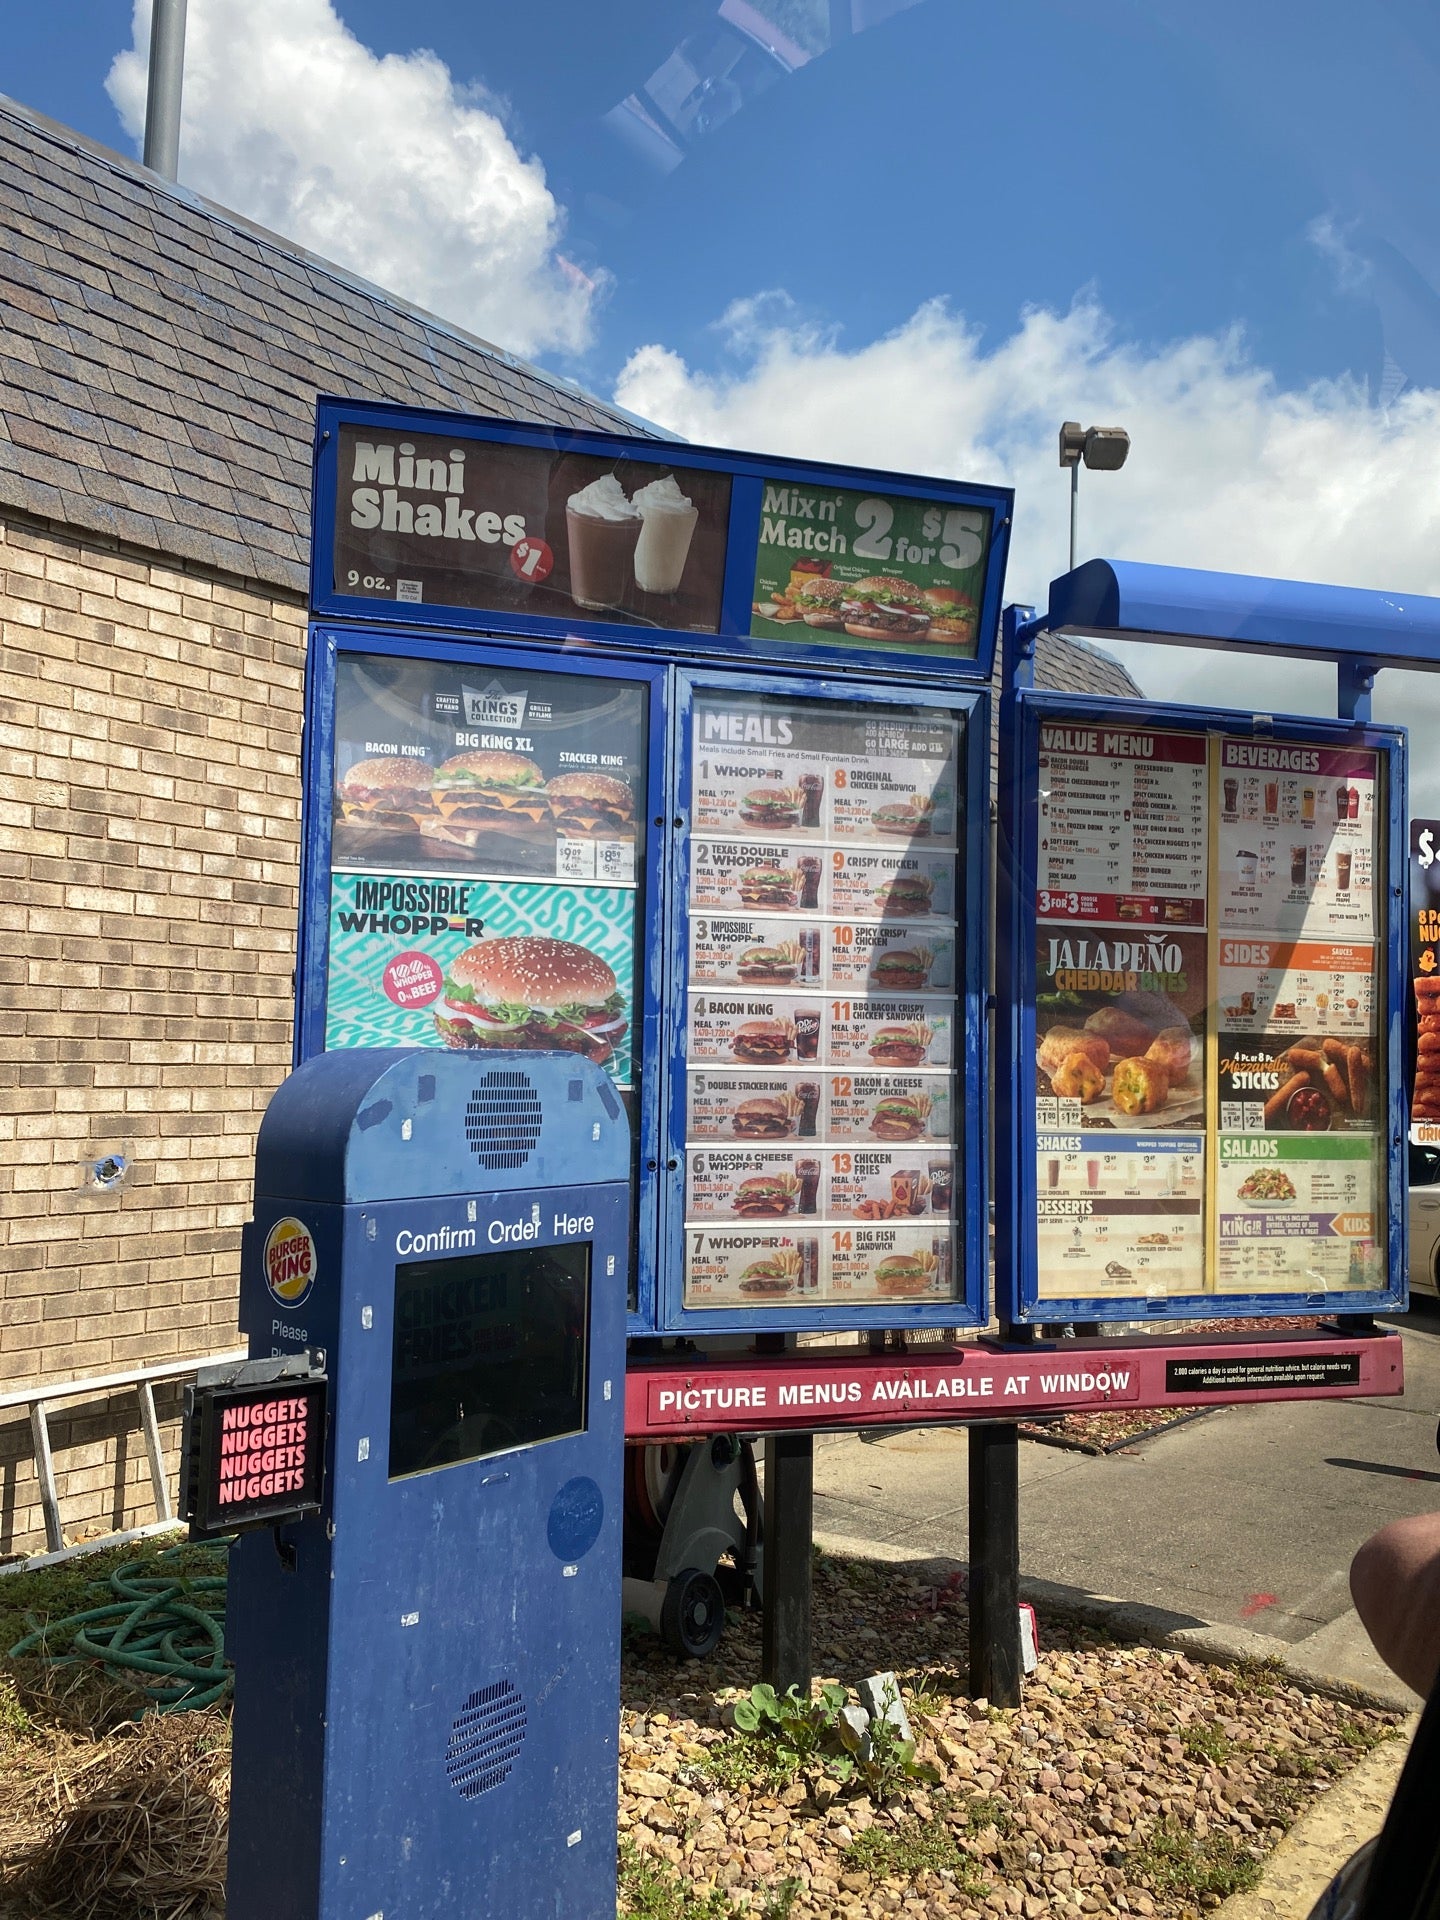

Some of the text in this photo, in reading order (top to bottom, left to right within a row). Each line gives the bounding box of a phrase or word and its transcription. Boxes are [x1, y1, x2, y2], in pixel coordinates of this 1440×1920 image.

[352, 441, 466, 494] Mini
[762, 485, 817, 517] Mix
[351, 487, 526, 546] Shakes
[759, 517, 847, 555] Match
[852, 498, 894, 561] 2
[896, 537, 936, 565] for
[516, 541, 542, 576] $1
[347, 570, 359, 586] 9
[362, 574, 391, 591] oz.
[436, 696, 459, 704] CRAFTED
[471, 699, 518, 716] KING'S
[471, 713, 517, 724] COLLECTION
[704, 710, 793, 746] MEALS
[365, 742, 398, 755] BACON
[455, 732, 534, 752] BIG KING XL
[1041, 729, 1154, 757] VALUE MENU
[559, 751, 598, 764] STACKER
[699, 744, 870, 765] Meals include Small Fries and Small Fountain Drink
[1226, 744, 1320, 772] BEVERAGES
[699, 759, 709, 780] 1
[834, 768, 893, 789] 8 ORIGINAL
[850, 781, 917, 793] CHICKEN SANDWICH
[696, 843, 789, 864] 2 TEXAS DOUBLE
[833, 851, 919, 871] 9 CRISPY CHICKEN
[1039, 891, 1051, 913] 3
[1051, 898, 1067, 909] FOR
[1418, 909, 1427, 925] 8
[696, 919, 754, 940] 3 IMPOSSIBLE
[832, 925, 908, 946] 10 SPICY CRISPY
[1419, 924, 1440, 942] NU
[855, 936, 888, 947] CHICKEN
[1046, 934, 1183, 977] JALAPEÑO
[1224, 943, 1270, 965] SIDES
[392, 970, 433, 988] WHOPPER
[1055, 969, 1188, 993] CHEDDAR BITES
[411, 981, 437, 999] BEEF
[694, 997, 774, 1017] 4 BACON KING
[831, 1001, 924, 1021] 11 BBQ BACON CRISPY
[853, 1011, 925, 1021] CHICKEN SANDWICH
[1220, 1058, 1290, 1075] Mozzarella
[693, 1075, 788, 1095] 5 DOUBLE STACKER KING
[830, 1076, 923, 1097] 12 BACON & CHEESE
[1231, 1071, 1280, 1089] STICKS
[854, 1088, 908, 1096] CRISPY CHICKEN
[1037, 1136, 1082, 1150] SHAKES
[1223, 1139, 1278, 1158] SALADS
[693, 1153, 793, 1174] 6 BACON & CHEESE
[831, 1153, 892, 1174] 13 CHICKEN
[854, 1164, 880, 1175] FRIES
[1037, 1200, 1094, 1215] DESSERTS
[396, 1213, 594, 1256] Confirm Order Here
[1222, 1219, 1252, 1236] KING
[1343, 1217, 1370, 1232] KIDS
[268, 1234, 310, 1263] BURGER
[693, 1233, 705, 1254] 7
[779, 1236, 794, 1248] Jr.
[831, 1231, 896, 1251] 14 BIG FISH
[856, 1242, 893, 1251] SANDWICH
[270, 1250, 312, 1287] KING
[272, 1319, 308, 1342] Please
[1188, 1366, 1207, 1375] calories
[1212, 1366, 1221, 1375] day
[1227, 1366, 1238, 1374] used
[1247, 1365, 1264, 1375] general
[1265, 1364, 1284, 1373] nutrition
[1301, 1363, 1309, 1371] but
[1309, 1363, 1326, 1371] calorie
[1327, 1362, 1340, 1370] needs
[1340, 1364, 1352, 1372] vary.
[1203, 1373, 1325, 1384] Additional nutrition information available upon request.
[659, 1371, 1131, 1412] PICTURE MENUS AVAILABLE AT WINDOW
[222, 1397, 308, 1431] NUGGETS
[220, 1420, 307, 1455] NUGGETS
[219, 1444, 306, 1480] NUGGETS
[218, 1468, 305, 1505] NUGGETS
